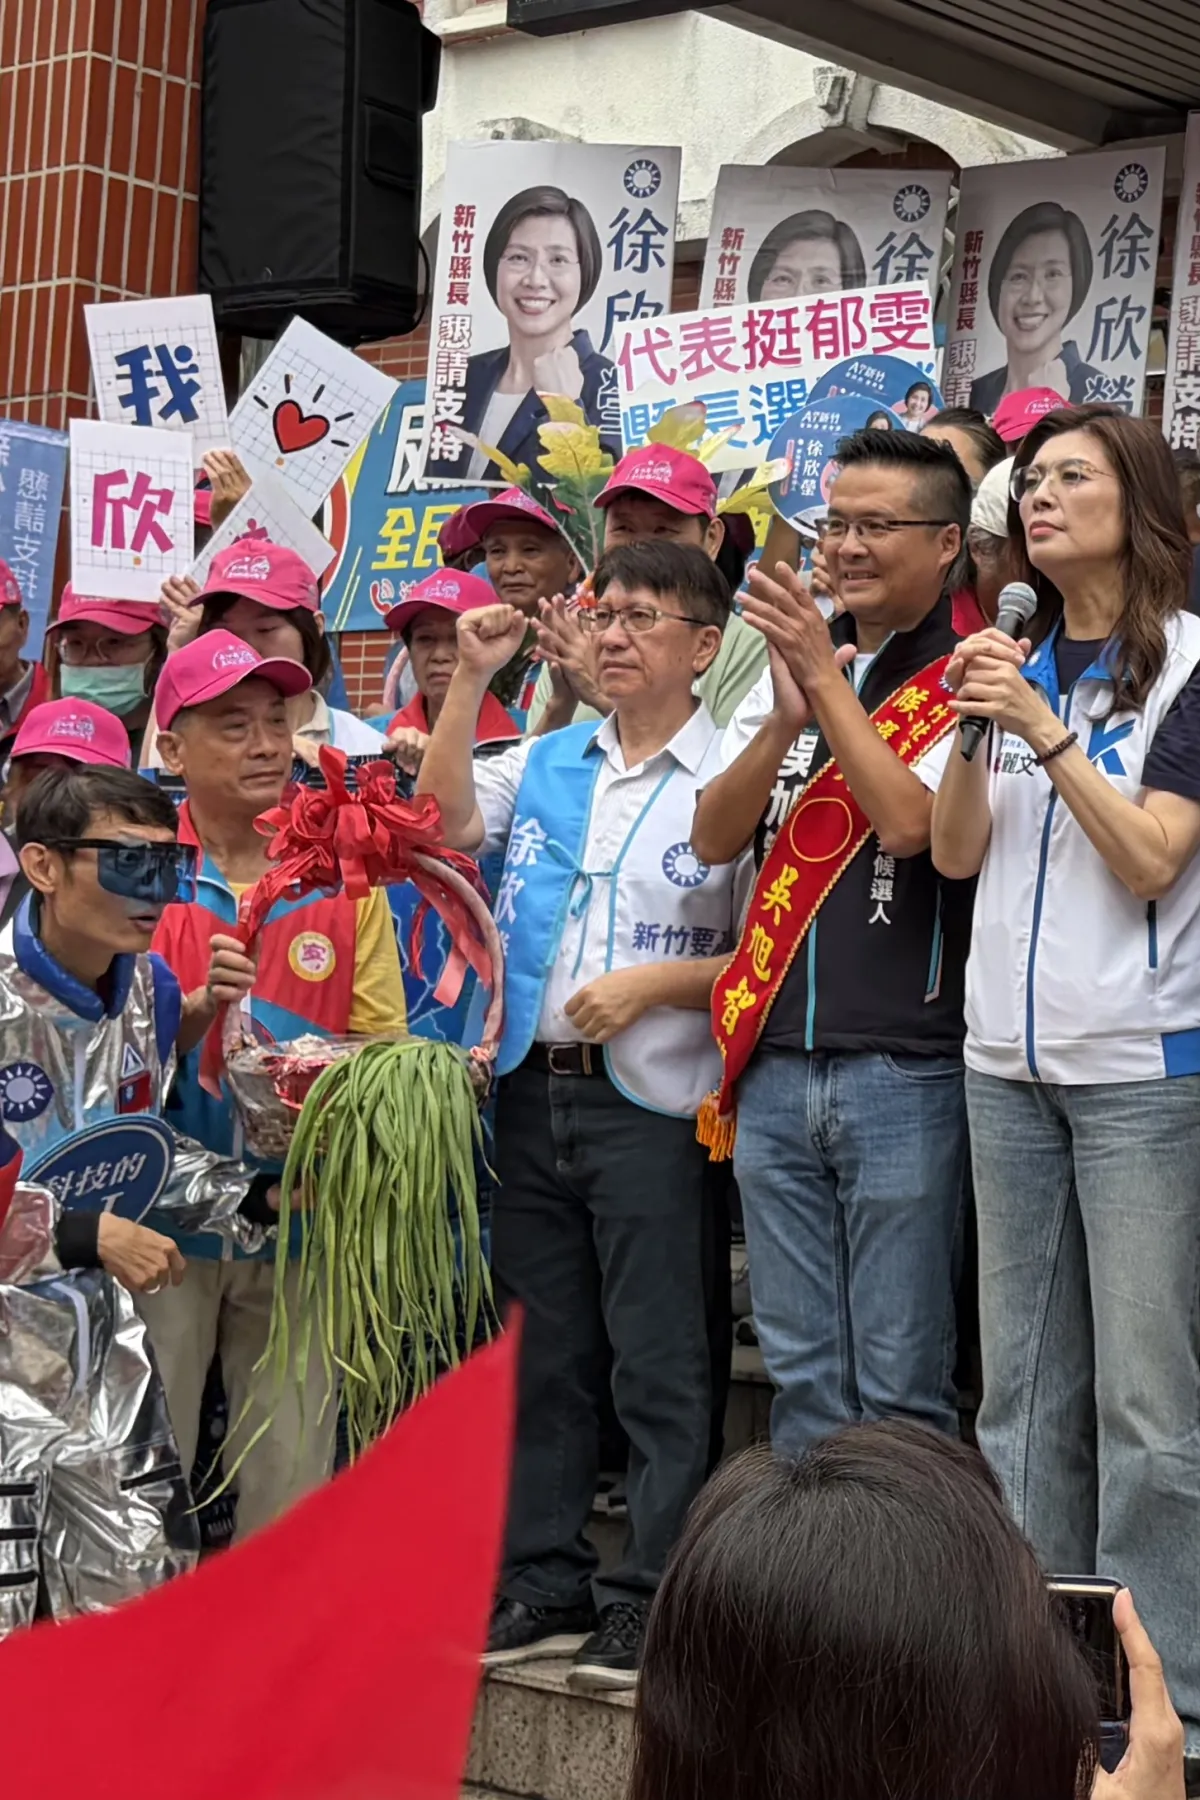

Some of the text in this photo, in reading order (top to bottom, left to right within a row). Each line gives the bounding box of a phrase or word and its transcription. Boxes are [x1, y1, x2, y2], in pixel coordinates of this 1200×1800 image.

[713, 227, 745, 308] 新竹縣
[956, 230, 984, 331] 新竹縣長
[430, 203, 477, 462] 新竹縣長 懇請支持
[617, 289, 931, 392] 代表挺郁雯
[115, 344, 200, 426] 我
[91, 469, 174, 553] 欣
[994, 751, 1036, 777] 麗文
[868, 839, 896, 925] 候選人
